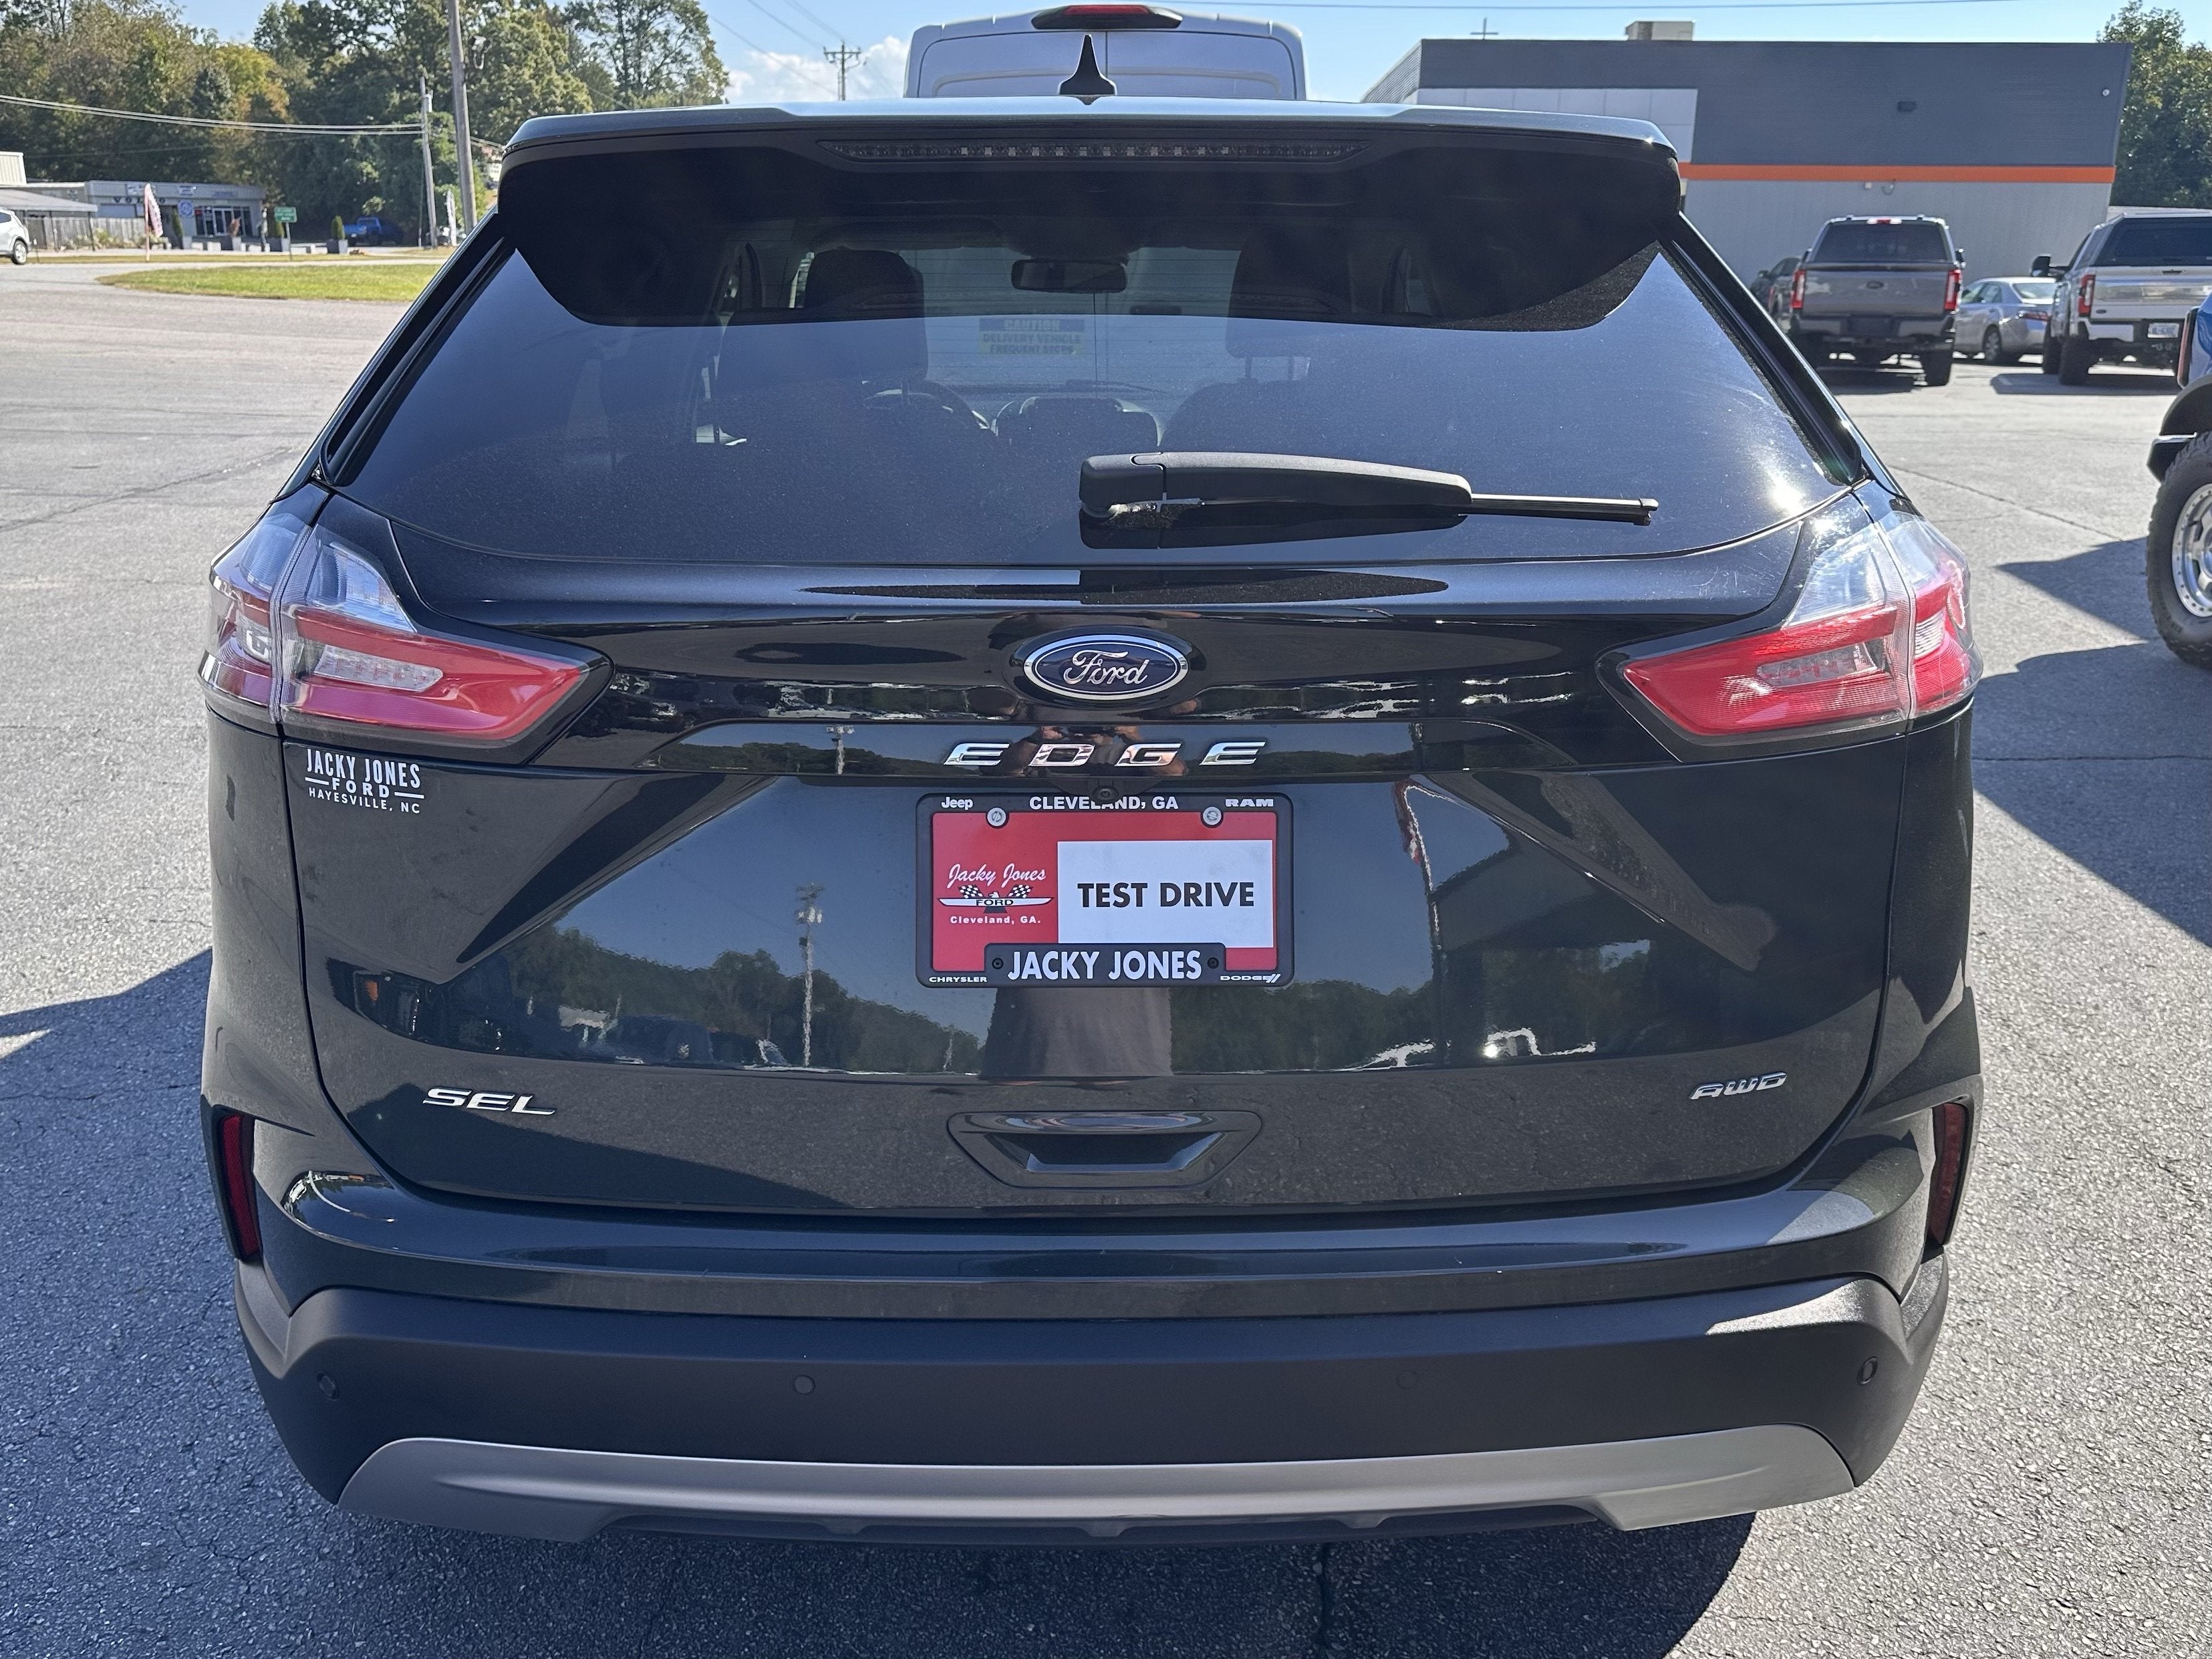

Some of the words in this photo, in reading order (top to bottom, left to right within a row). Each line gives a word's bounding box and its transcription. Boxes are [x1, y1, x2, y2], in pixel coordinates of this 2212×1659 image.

[1004, 319, 1061, 331] CAUTION
[983, 333, 1034, 343] DELIVERY
[1036, 334, 1081, 344] VEHICLE
[990, 344, 1041, 354] FREQUENT
[1063, 649, 1148, 686] Ford
[944, 741, 1266, 767] EDGE
[307, 749, 356, 780] JACKY
[365, 758, 420, 789] JONES
[331, 777, 390, 798] FORD
[309, 787, 393, 811] HAYESVILLE,
[400, 801, 420, 814] NC
[941, 796, 974, 810] Jeep
[1151, 796, 1179, 809] GA
[1225, 798, 1274, 807] RAM
[946, 863, 996, 889] Jacky
[1001, 863, 1047, 888] Jones
[976, 898, 1014, 906] FORD
[1077, 882, 1148, 908] TEST
[1159, 882, 1254, 907] DRIVE
[950, 916, 1015, 925] Cleveland,
[1020, 915, 1041, 924] GA.
[1007, 950, 1100, 980] JACKY
[1108, 950, 1202, 980] JONES
[1689, 1071, 1788, 1100] AWD
[423, 1088, 556, 1116] SEL
